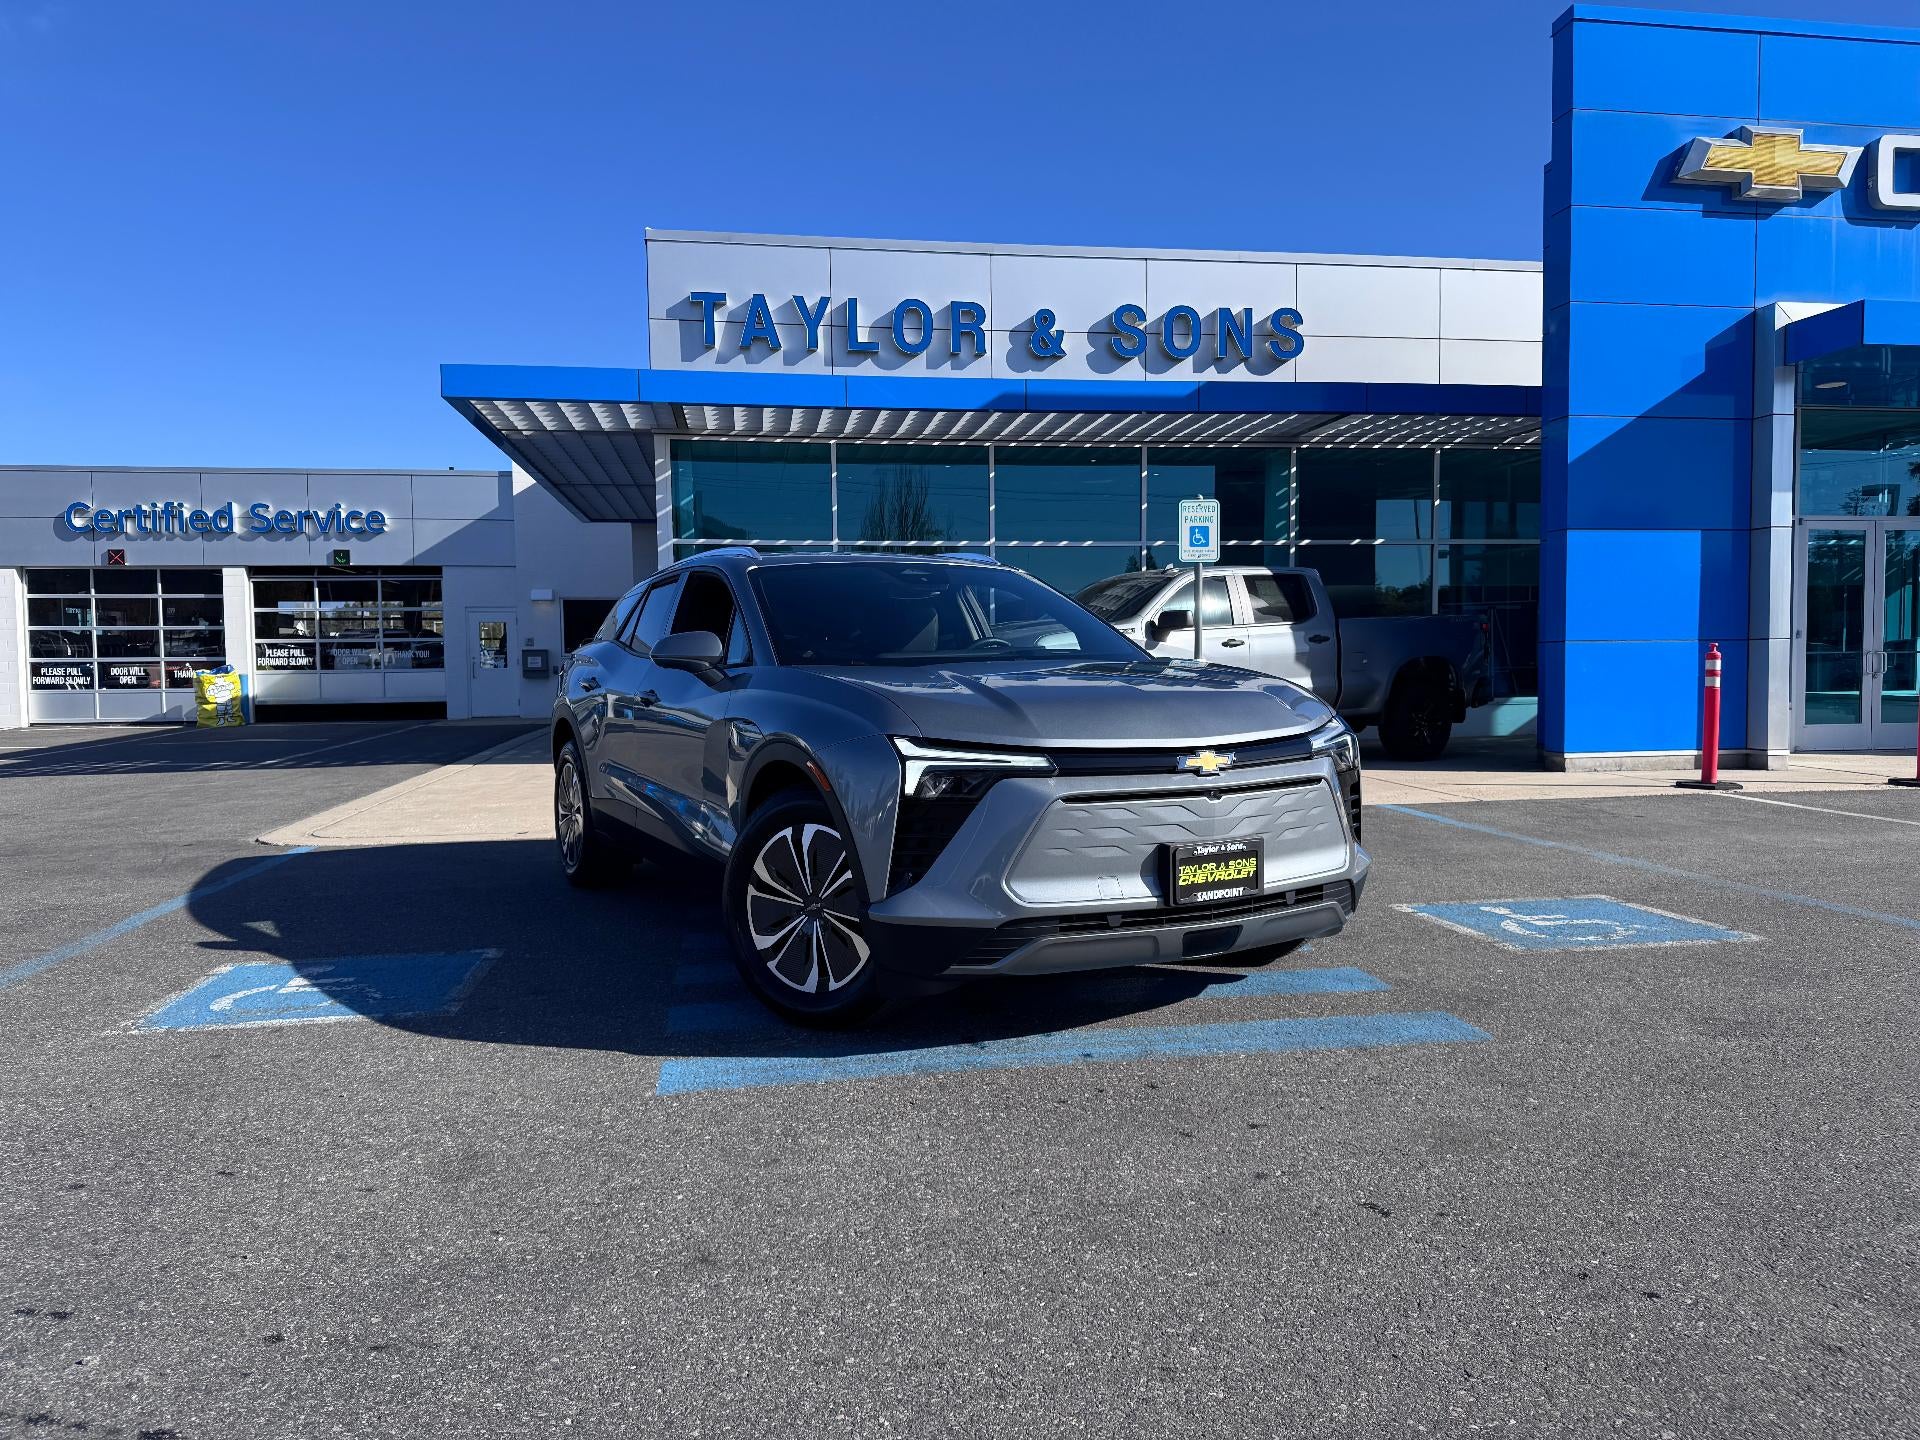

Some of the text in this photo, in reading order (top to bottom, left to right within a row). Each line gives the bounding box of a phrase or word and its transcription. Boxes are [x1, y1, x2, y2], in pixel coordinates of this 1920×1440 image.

[690, 291, 1305, 361] TAYLOR & SONS
[1183, 505, 1216, 513] RESERVED
[64, 501, 387, 534] Certified Service
[1184, 516, 1214, 524] PARKING
[265, 649, 306, 657] PLEASE PULL
[394, 650, 430, 659] THANK YOU!
[257, 657, 314, 666] FORWARD SLOWLY
[342, 656, 358, 665] OPEN
[41, 667, 83, 676] PLEASE PULL
[110, 667, 146, 676] DOOR WILL
[32, 676, 91, 685] FORWARD SLOWLY
[119, 676, 137, 685] OPEN
[1179, 863, 1216, 874] TAYLOR
[1229, 858, 1256, 868] SONS
[1179, 869, 1257, 885] CHEVROLET
[1197, 887, 1244, 901] SANDPOINT
